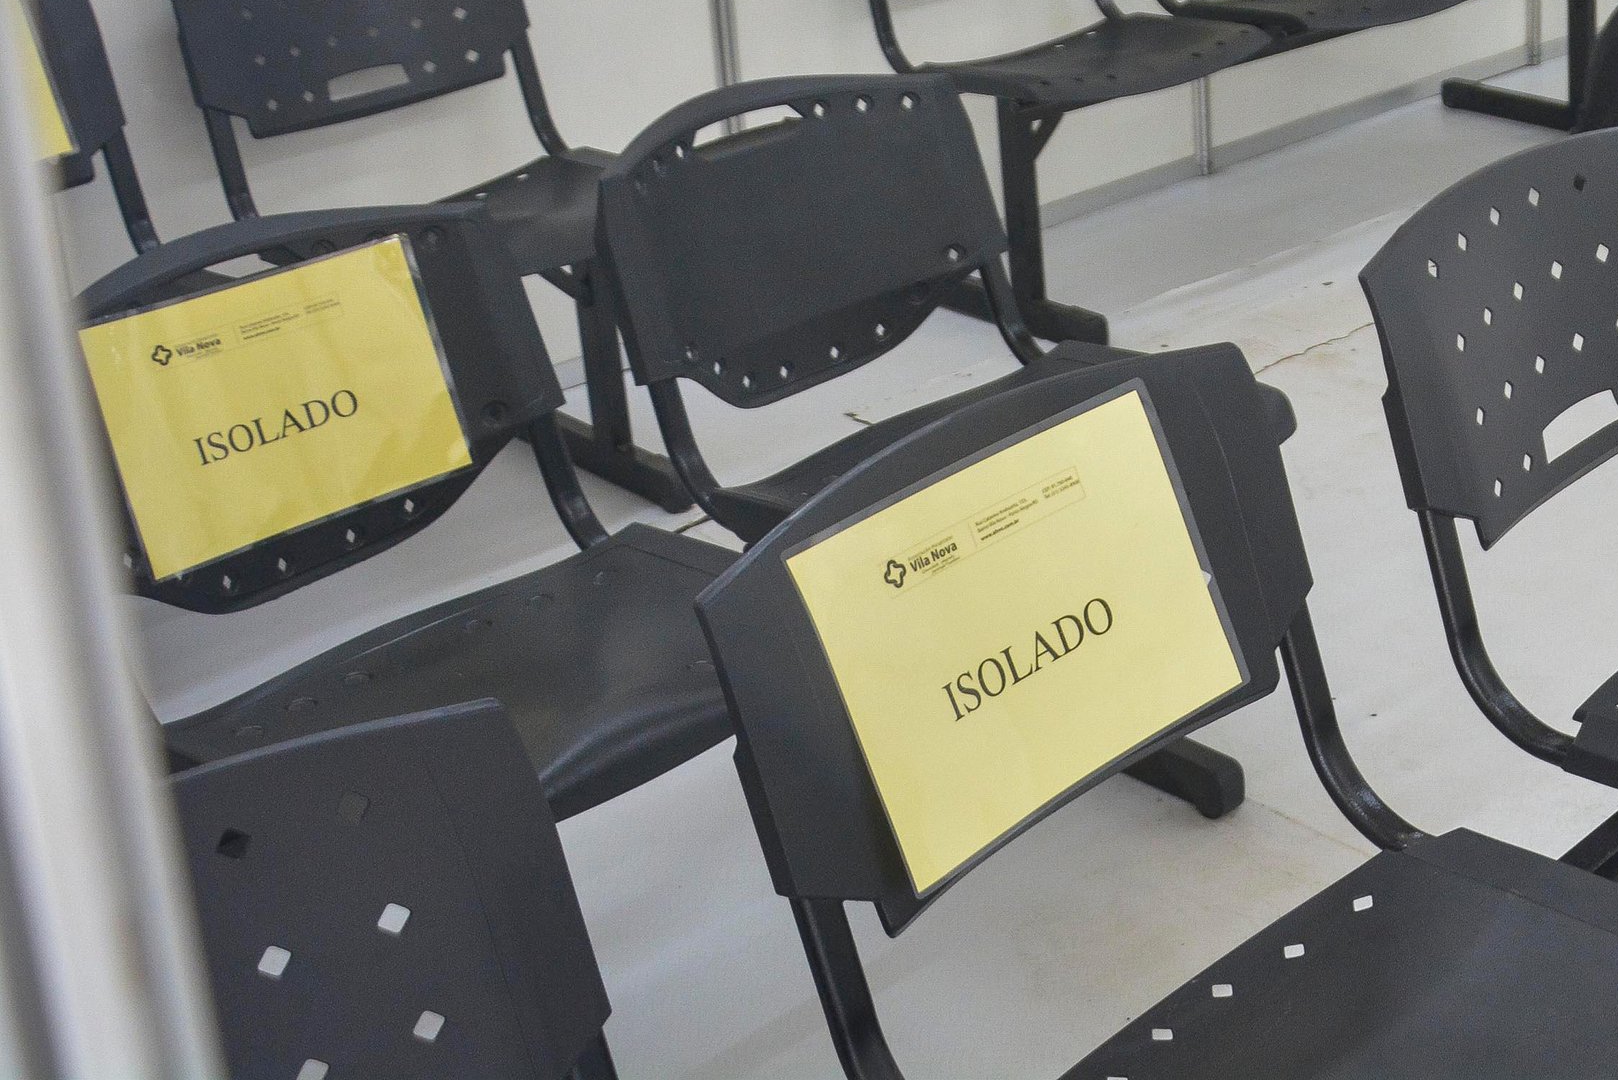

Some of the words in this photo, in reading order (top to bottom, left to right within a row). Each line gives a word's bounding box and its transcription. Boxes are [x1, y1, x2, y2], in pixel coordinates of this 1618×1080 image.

[175, 342, 196, 357] Vila
[196, 337, 222, 352] Nova
[193, 388, 358, 466] ISOLADO
[910, 556, 931, 572] Vila
[931, 542, 957, 562] Nova
[941, 597, 1114, 722] ISOLADO
